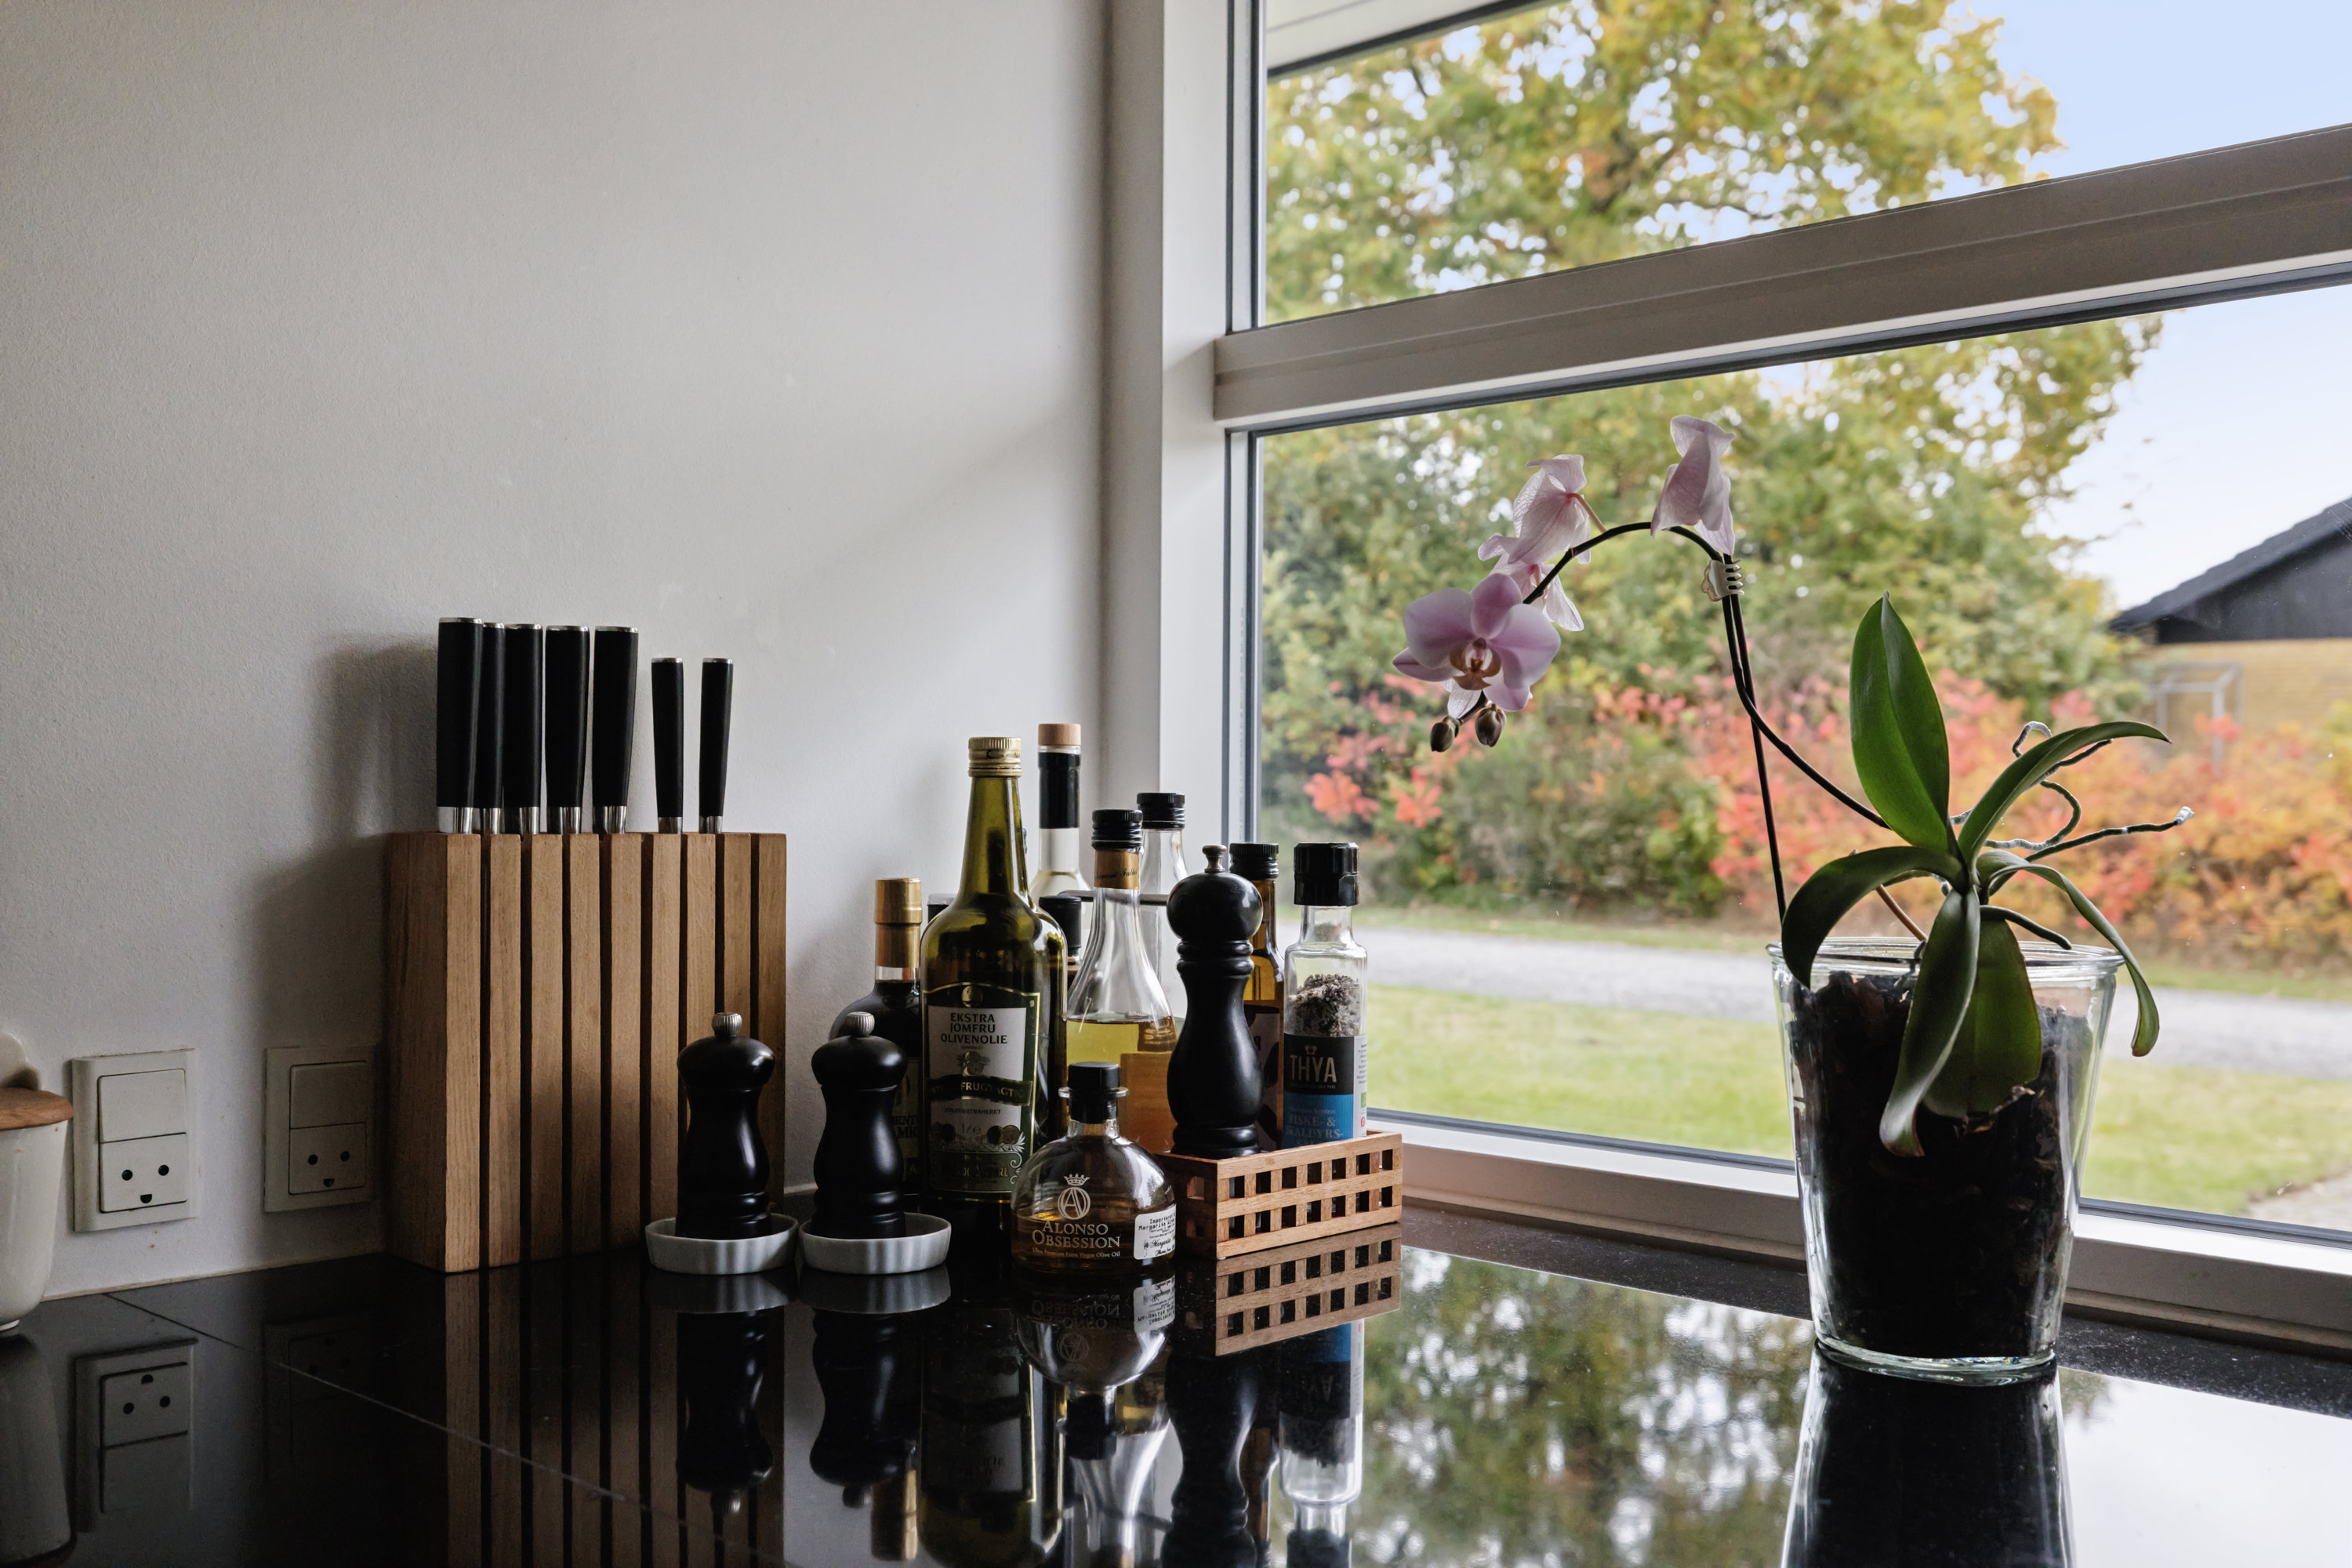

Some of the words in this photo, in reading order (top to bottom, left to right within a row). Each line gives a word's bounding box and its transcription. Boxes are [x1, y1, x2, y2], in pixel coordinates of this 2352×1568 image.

[950, 1012, 996, 1023] EKSTRA
[949, 1022, 996, 1033] JOMFRU
[940, 1033, 1008, 1044] OLIVENOLIE
[1290, 1054, 1337, 1083] THYA
[1326, 1116, 1336, 1127] &
[1042, 1220, 1109, 1236] ALONSO
[1032, 1229, 1121, 1249] OBSESSION
